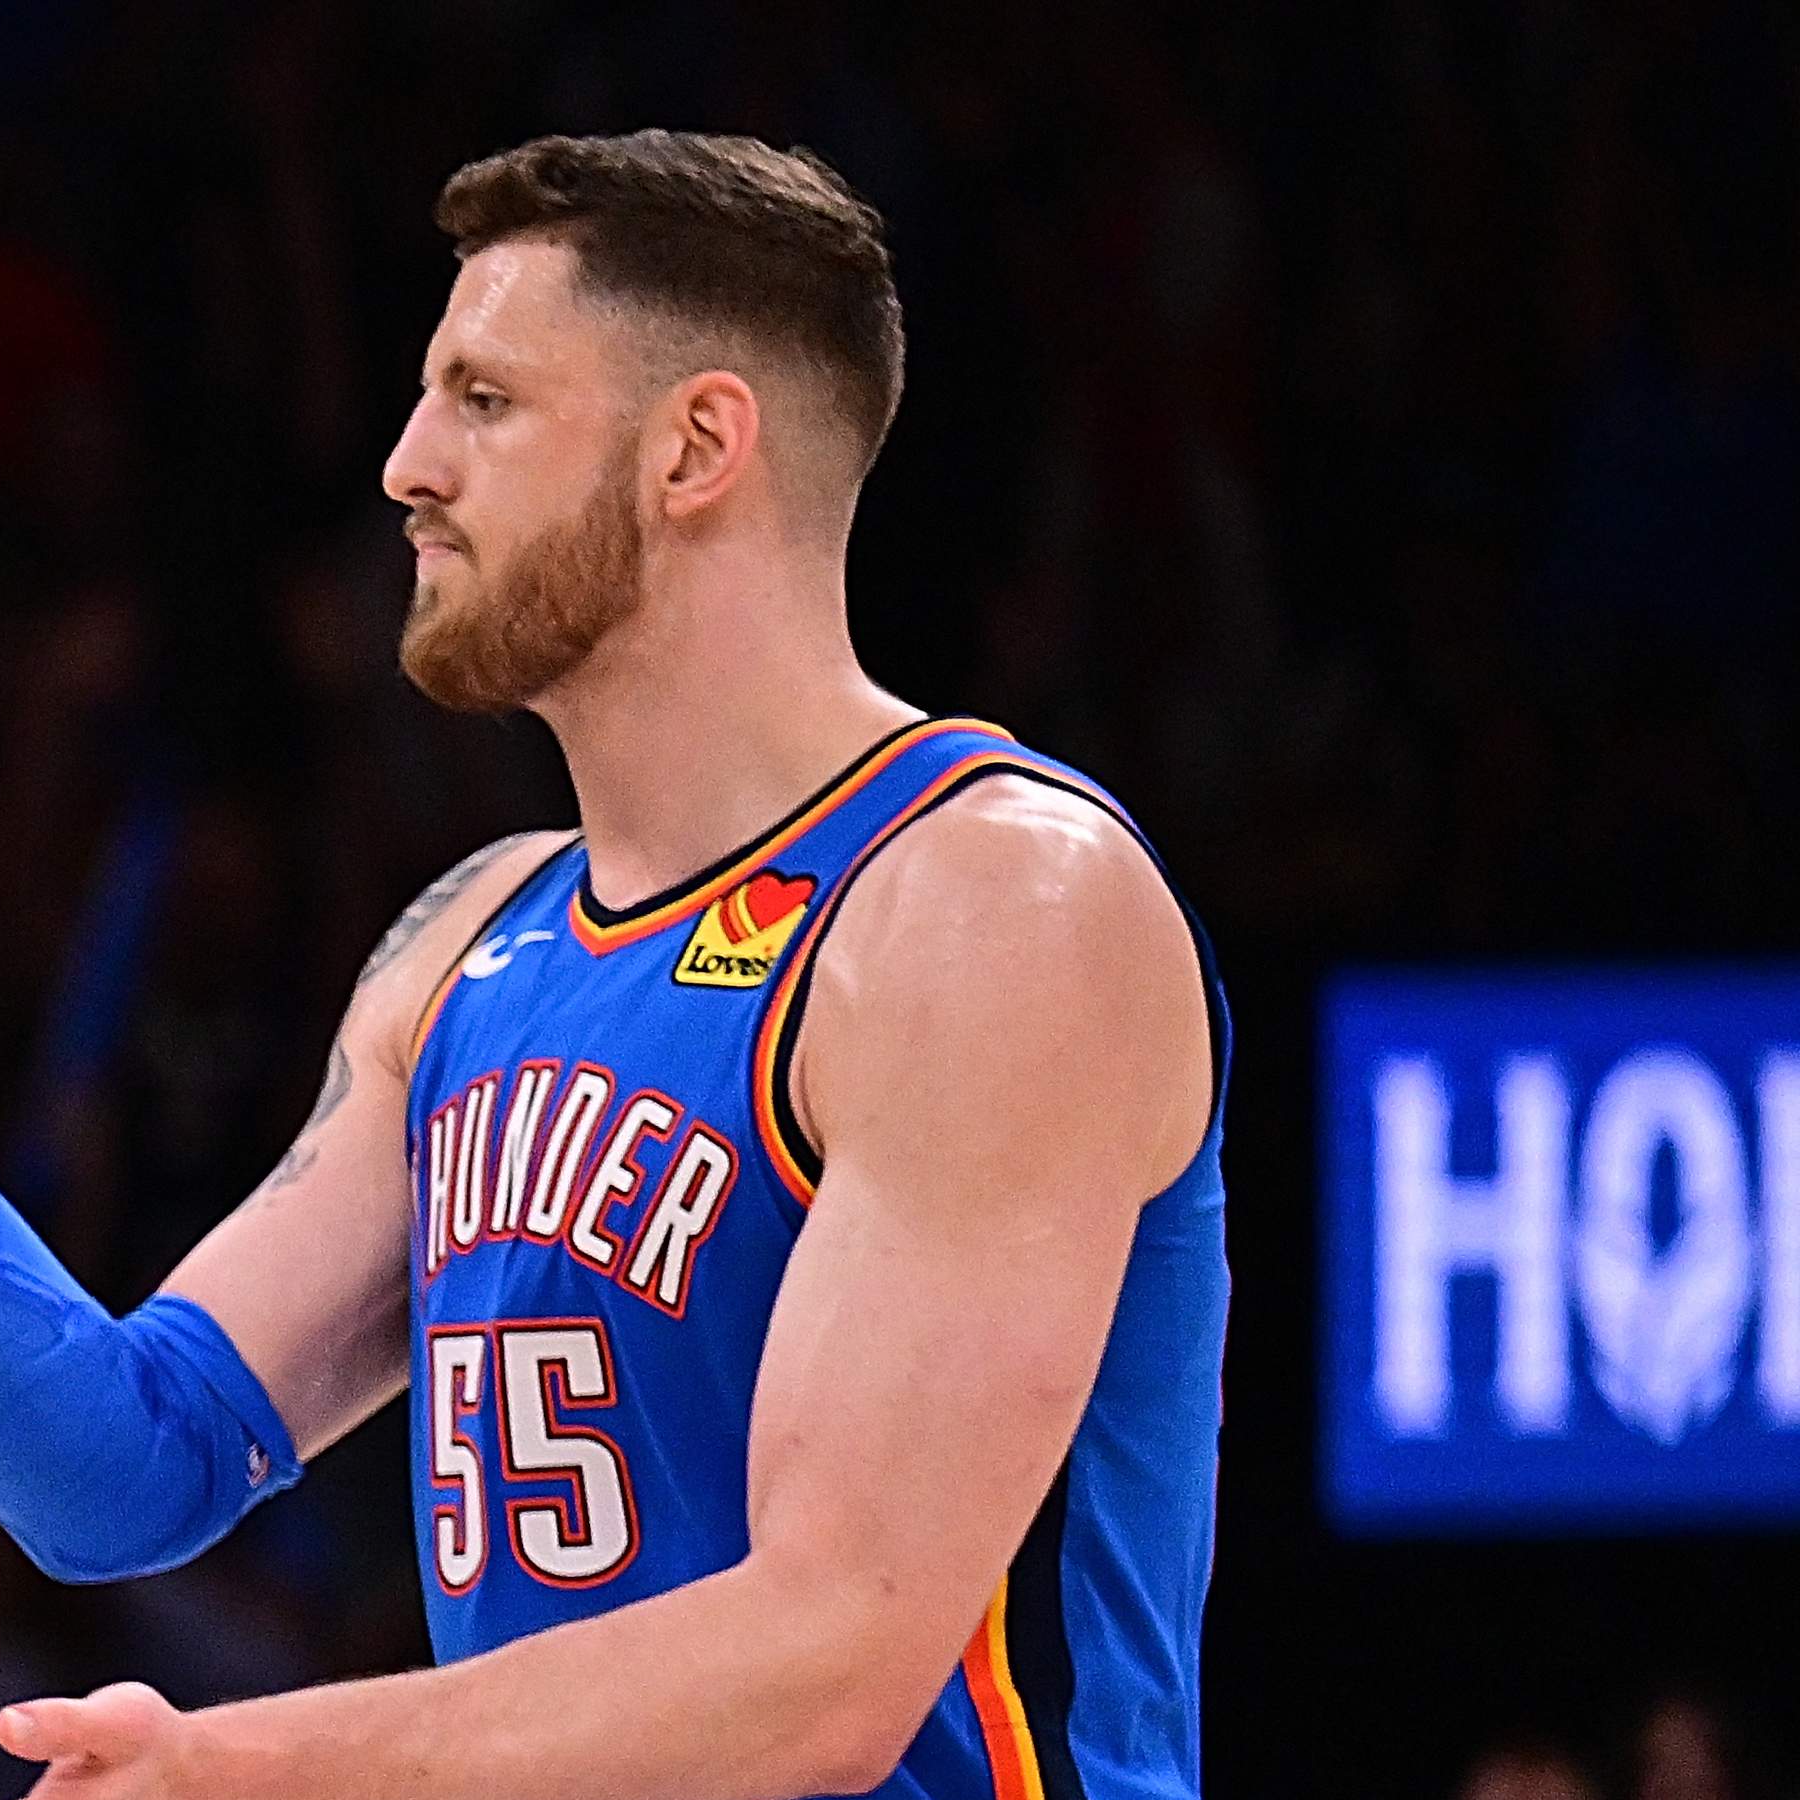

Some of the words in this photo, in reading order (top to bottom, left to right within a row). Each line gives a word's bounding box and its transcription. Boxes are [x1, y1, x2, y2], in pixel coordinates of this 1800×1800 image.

[414, 1059, 739, 1320] HUNDER
[1372, 1045, 1800, 1446] HO
[426, 1319, 641, 1596] 55
